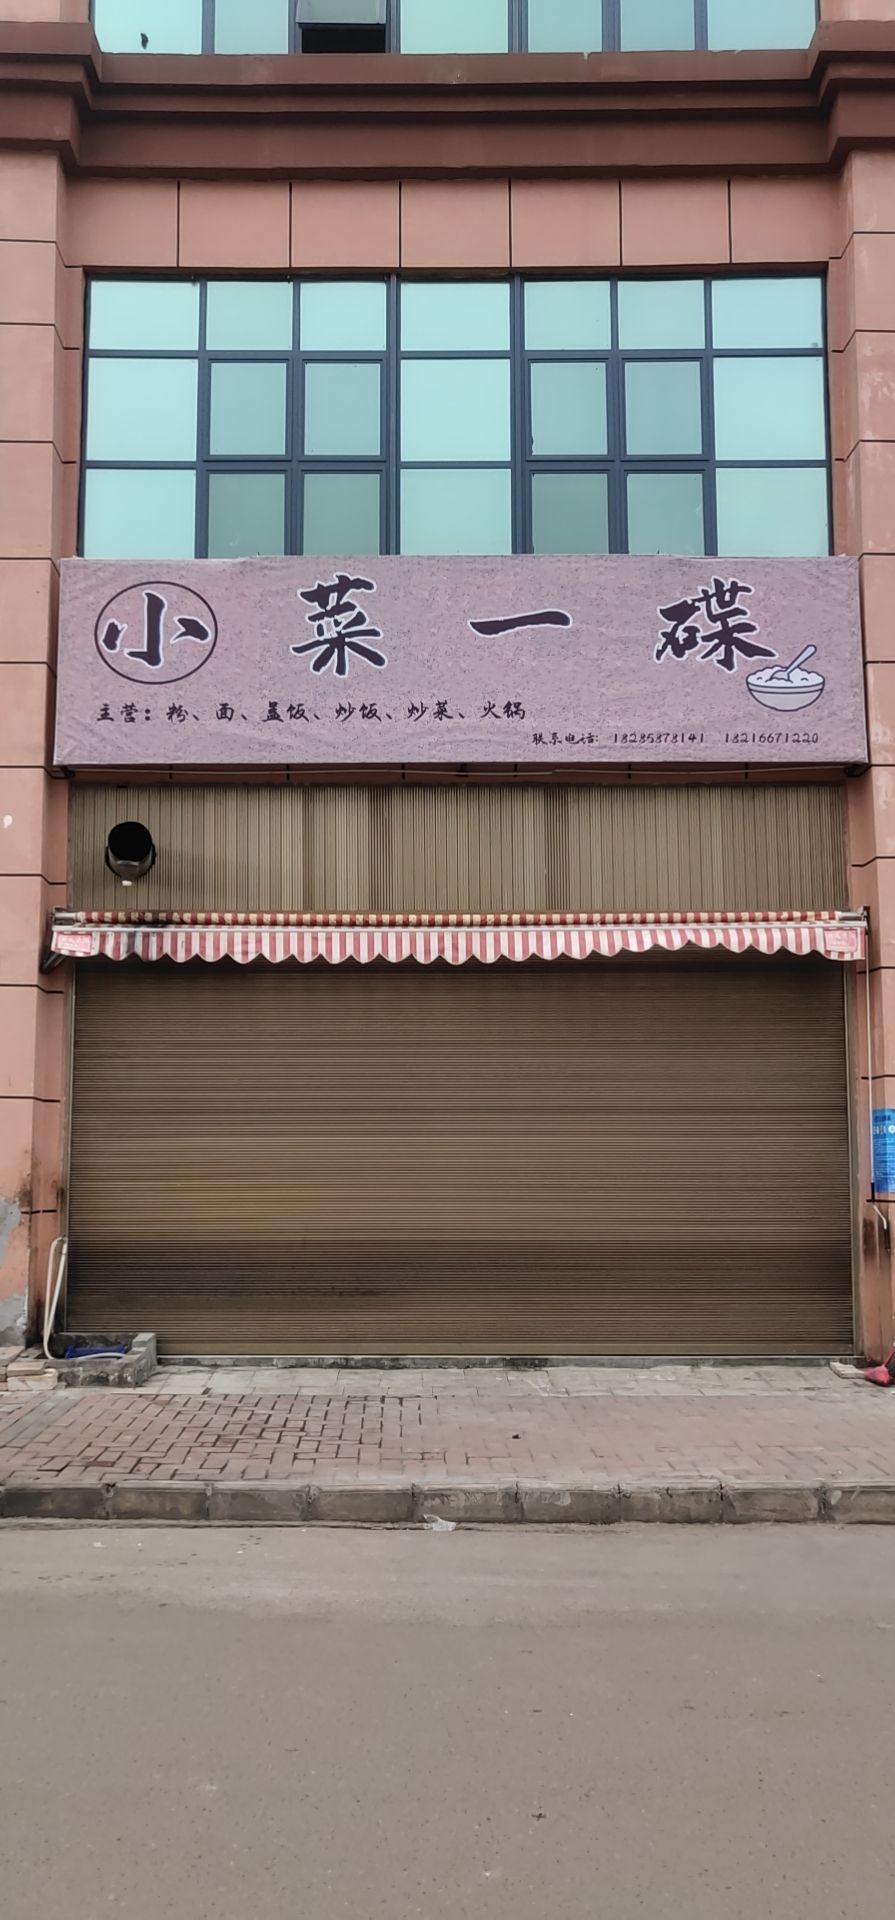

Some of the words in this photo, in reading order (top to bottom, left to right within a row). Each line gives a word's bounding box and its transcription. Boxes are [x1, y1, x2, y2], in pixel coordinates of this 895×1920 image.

[102, 574, 778, 675] 小菜一碟
[613, 733, 704, 744] 18285878141
[725, 732, 819, 744] 18216671220
